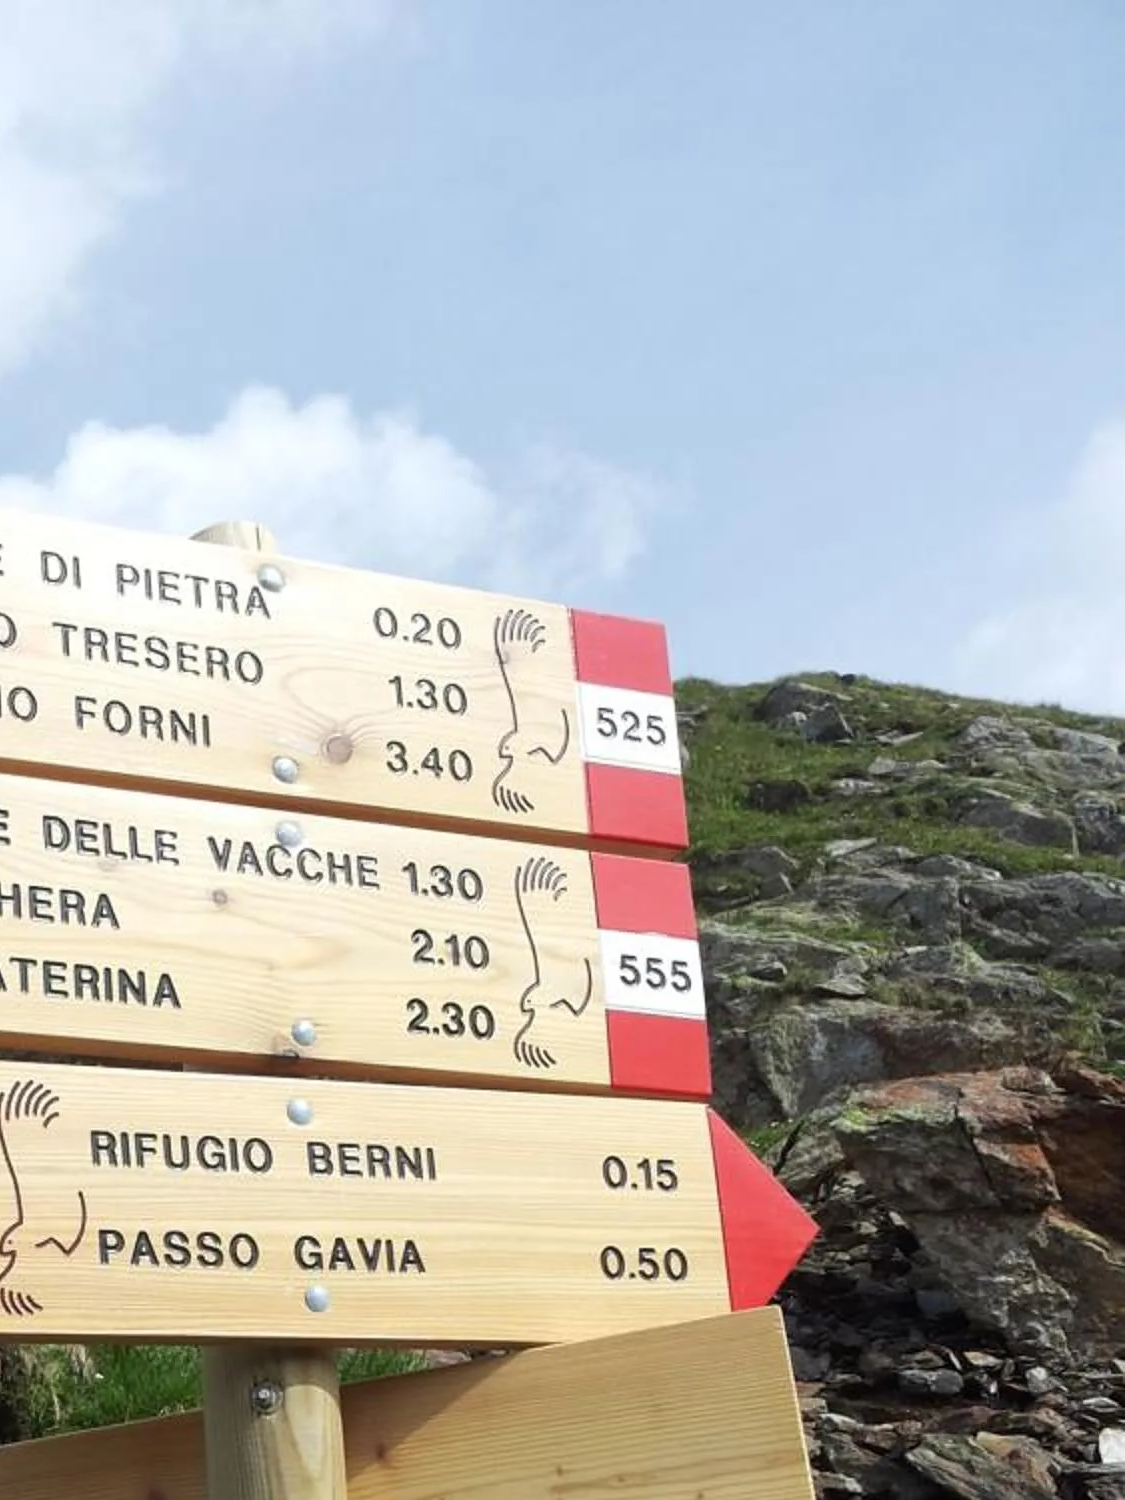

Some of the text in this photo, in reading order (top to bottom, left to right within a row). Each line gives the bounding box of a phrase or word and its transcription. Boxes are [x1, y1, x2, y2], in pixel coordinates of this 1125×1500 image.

[40, 550, 82, 587] DI
[116, 563, 272, 619] PIETRA
[373, 606, 463, 650] 0.20
[52, 621, 264, 686] TRESERO
[388, 675, 468, 716] 1.30
[75, 695, 211, 748] FORNI
[386, 740, 473, 782] 3.40
[596, 706, 667, 746] 525
[42, 815, 179, 866] DELLE
[207, 835, 380, 890] VACCHE
[402, 861, 484, 901] 1.30
[411, 928, 490, 970] 2.10
[619, 954, 692, 992] 555
[406, 998, 495, 1040] 2.30
[90, 1130, 678, 1191] RIFUGIO BERNI 0.15
[97, 1229, 688, 1281] PASSO GAVIA 0.50
